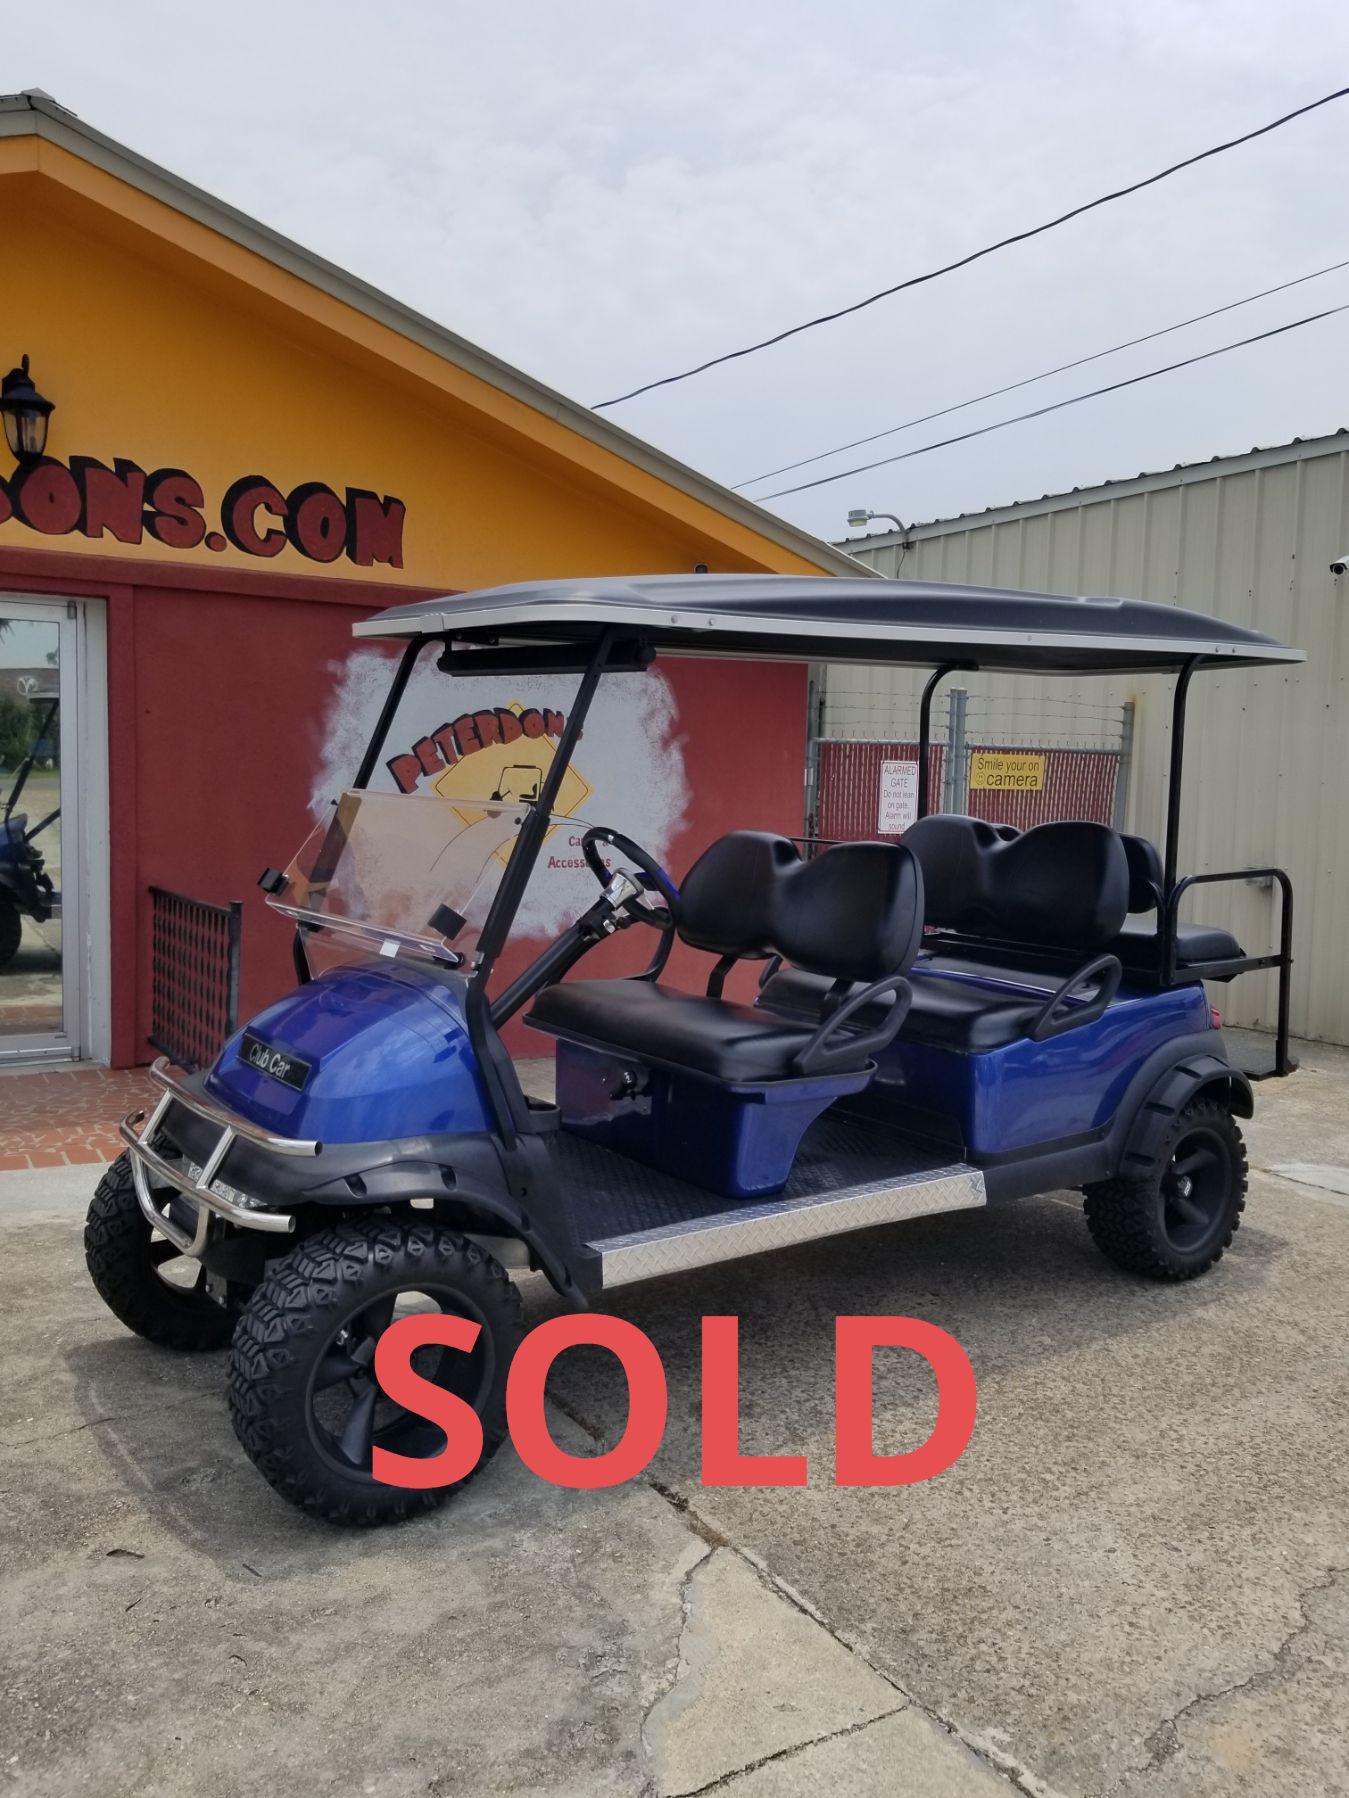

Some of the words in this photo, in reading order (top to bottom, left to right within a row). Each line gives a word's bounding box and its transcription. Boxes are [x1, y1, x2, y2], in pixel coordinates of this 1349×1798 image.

[0, 455, 405, 569] ONS.COM
[386, 707, 583, 794] PETERDON
[884, 765, 916, 775] ALARMED
[978, 757, 1004, 770] Smile
[1006, 761, 1027, 774] your
[1028, 762, 1040, 771] on
[890, 778, 908, 788] GATE
[987, 774, 1038, 786] camera
[883, 790, 891, 798] Do
[903, 791, 915, 799] lean
[885, 811, 901, 819] Alarm
[902, 811, 912, 819] will
[249, 1043, 269, 1068] Club
[269, 1053, 290, 1078] Car
